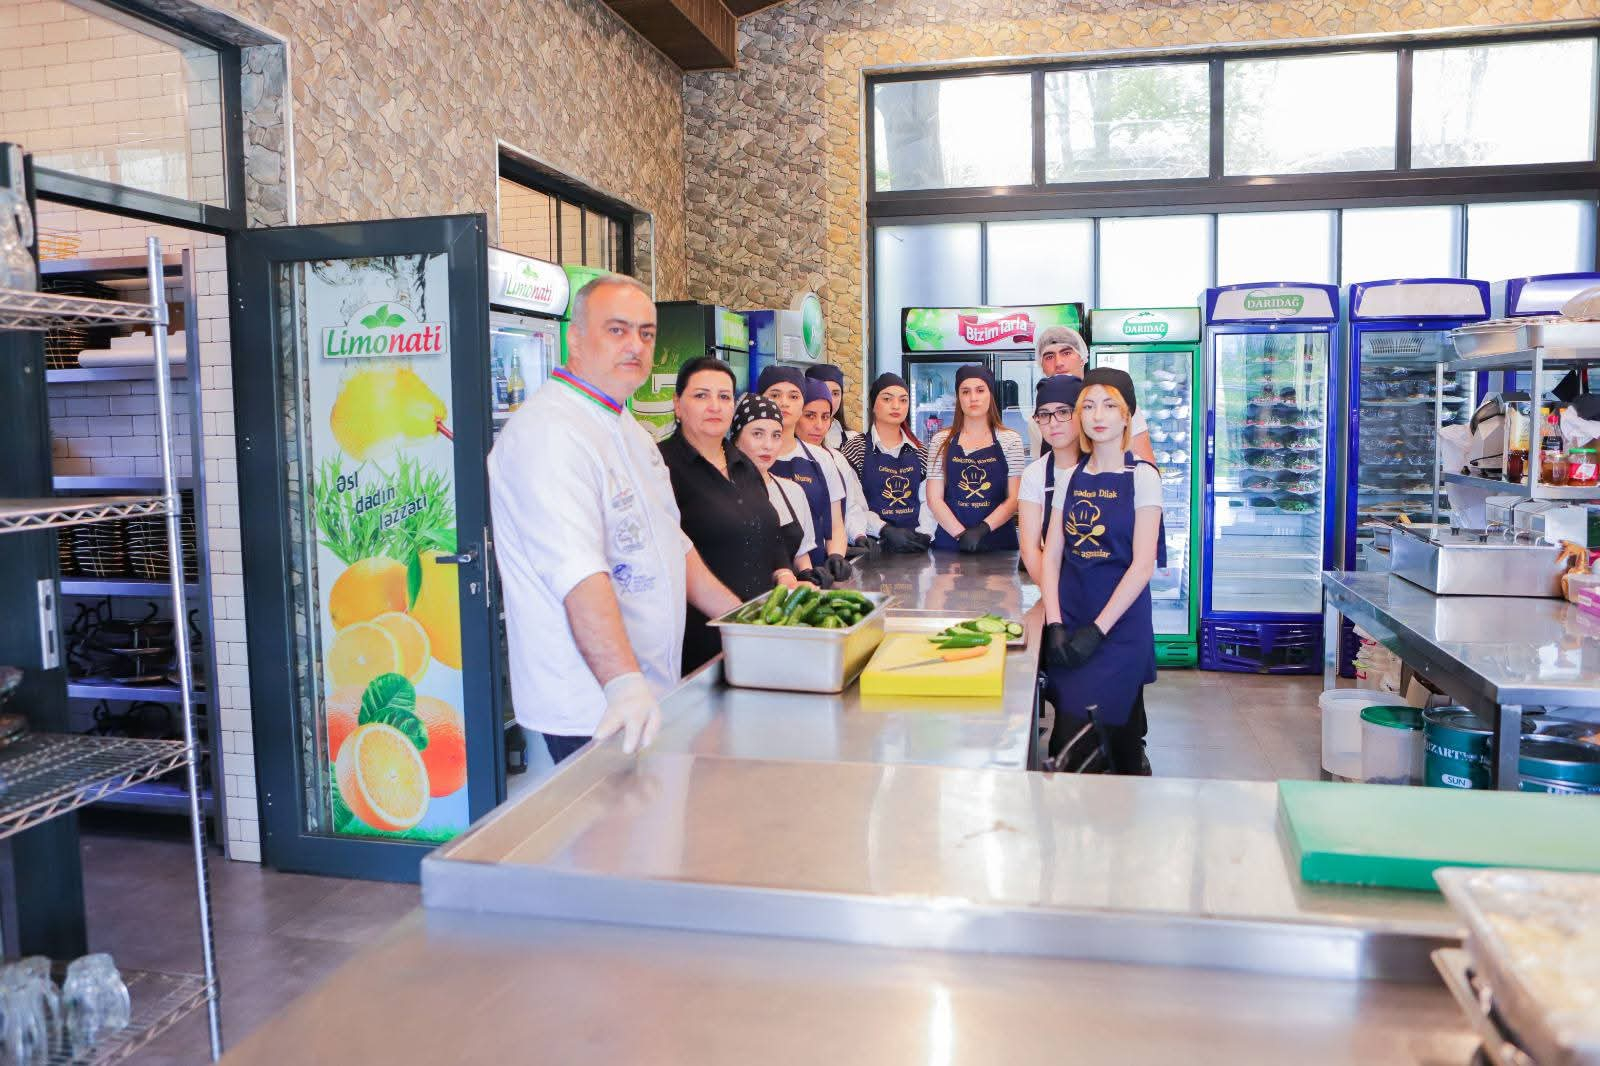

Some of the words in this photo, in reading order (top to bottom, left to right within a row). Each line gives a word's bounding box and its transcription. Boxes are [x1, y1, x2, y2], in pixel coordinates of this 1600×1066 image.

[507, 276, 553, 303] Limonati
[326, 325, 443, 357] Limonati
[966, 325, 999, 342] Bizim
[998, 317, 1028, 334] Tarla
[355, 486, 396, 515] dadın
[1447, 776, 1466, 787] SUN
